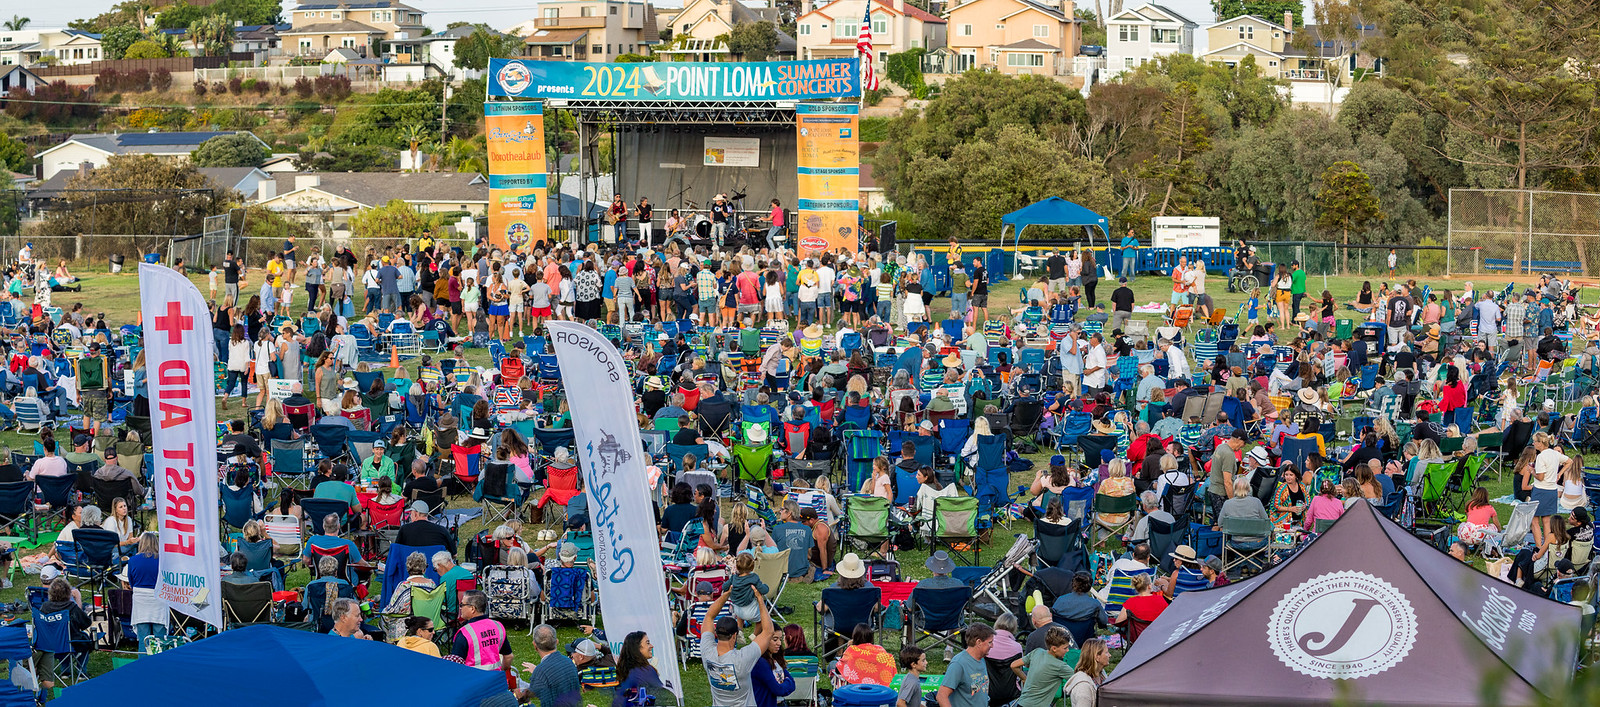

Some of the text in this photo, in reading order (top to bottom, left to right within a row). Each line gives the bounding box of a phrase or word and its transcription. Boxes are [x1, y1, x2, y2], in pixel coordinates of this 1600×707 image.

[581, 66, 641, 97] 2024
[666, 66, 775, 97] POINT LOMA
[777, 63, 852, 81] SUMMER
[537, 84, 575, 94] presents
[777, 77, 853, 96] CONCERTS
[513, 104, 538, 112] SPONSORS
[491, 150, 542, 162] DorotheaLaub
[1306, 587, 1325, 599] AND
[1326, 581, 1350, 590] THEN
[1353, 581, 1386, 599] THERE'S
[1284, 597, 1306, 624] QUALITY
[1384, 599, 1404, 630] JENSEN'S
[1461, 584, 1518, 651] Jensen's
[1298, 598, 1382, 656] J
[1517, 609, 1537, 635] FOODS
[1282, 626, 1296, 652] THERE'S
[1382, 631, 1403, 658] QUALITY
[1309, 659, 1364, 670] SINCE 1940
